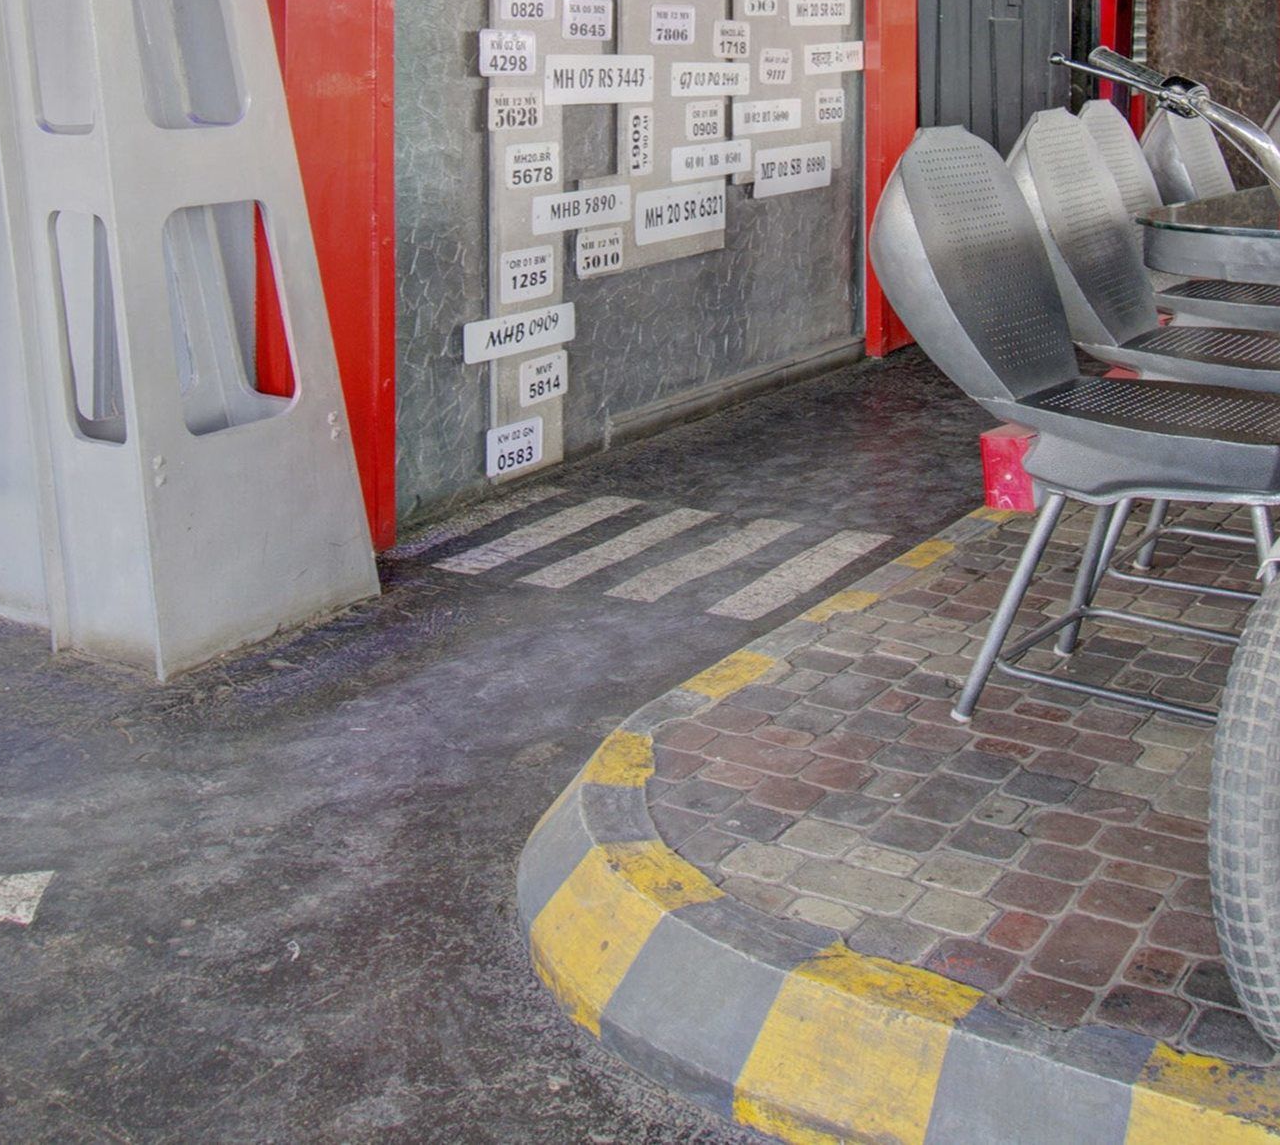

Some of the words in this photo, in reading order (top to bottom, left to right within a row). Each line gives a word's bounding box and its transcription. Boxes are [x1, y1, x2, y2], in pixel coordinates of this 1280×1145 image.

[511, 2, 544, 18] 0826
[569, 22, 606, 37] 9645
[656, 27, 689, 42] 7806
[719, 40, 748, 55] 1718
[489, 54, 529, 72] 4298
[553, 67, 575, 90] MH
[578, 67, 595, 90] 05
[598, 67, 614, 89] RS
[616, 67, 646, 89] 3443
[766, 68, 787, 81] 9111
[494, 107, 538, 129] 5628
[818, 107, 843, 121] 0500
[693, 121, 719, 136] 0908
[511, 166, 554, 185] 5678
[761, 161, 777, 181] MP
[550, 200, 581, 221] MHB
[585, 193, 617, 215] 5890
[645, 205, 664, 229] MH
[667, 203, 681, 225] 20
[684, 199, 697, 221] SR
[699, 194, 724, 218] 6321
[582, 252, 621, 271] 5010
[512, 270, 548, 290] 1285
[485, 322, 525, 350] MHB
[528, 311, 560, 337] 0909
[528, 374, 561, 400] 5814
[497, 445, 535, 471] 0583
